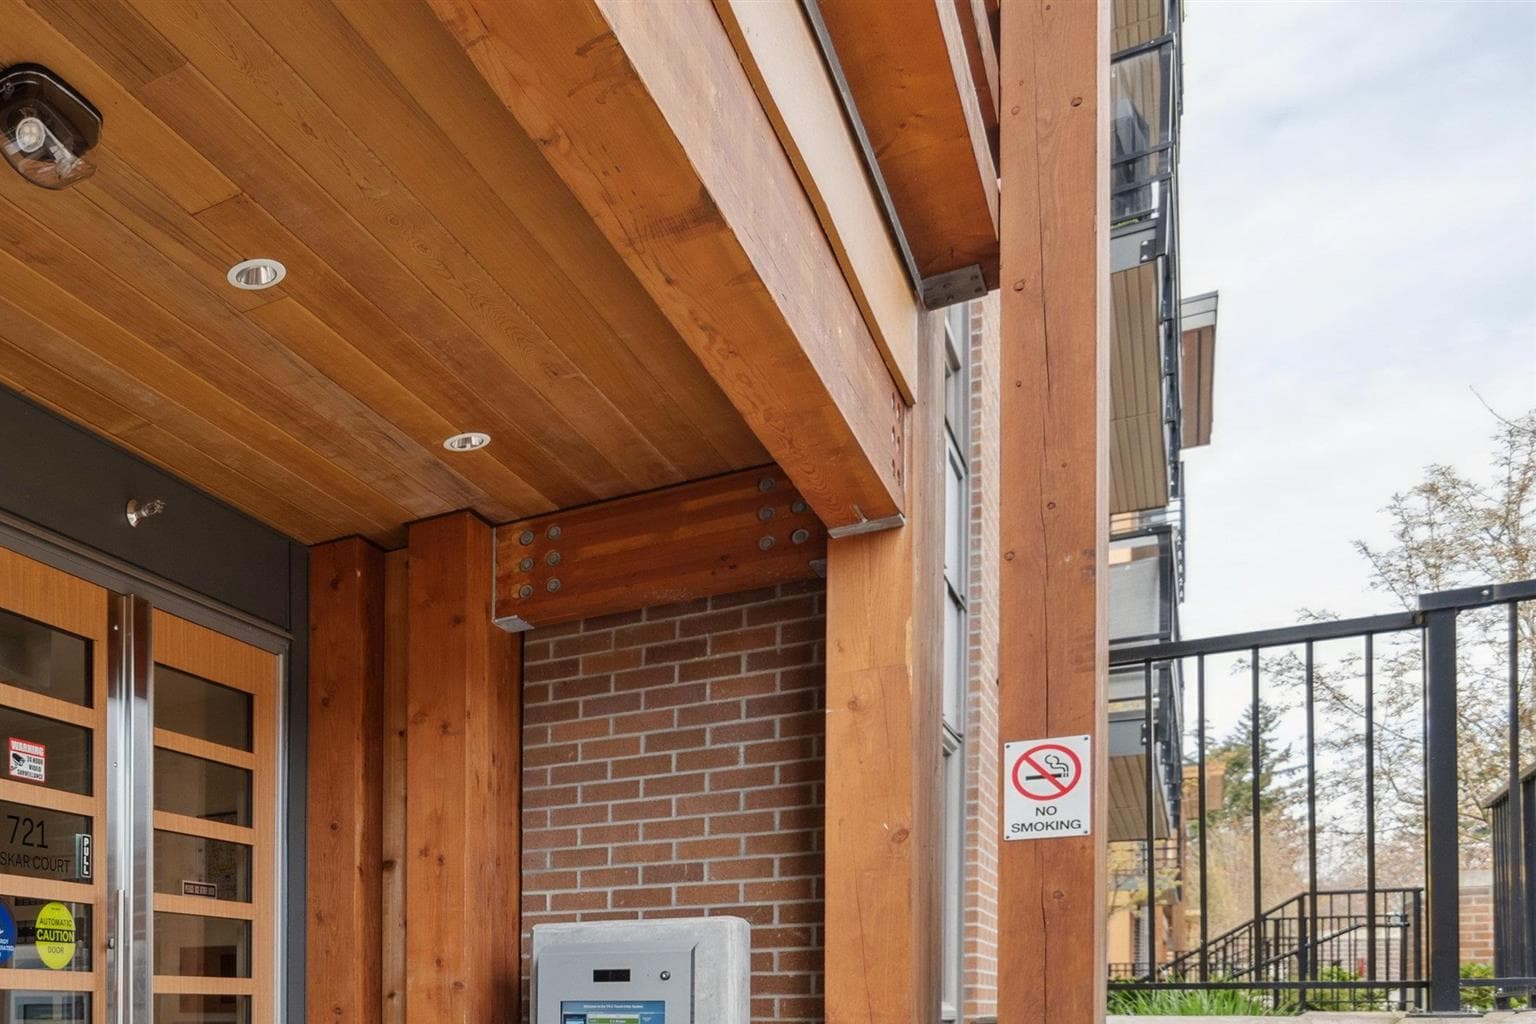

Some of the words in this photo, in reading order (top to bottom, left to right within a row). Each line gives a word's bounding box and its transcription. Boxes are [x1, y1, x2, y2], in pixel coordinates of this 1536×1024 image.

[1035, 805, 1057, 817] NO
[7, 815, 48, 849] 721
[1011, 819, 1082, 833] SMOKING
[82, 836, 90, 875] PULL
[33, 856, 72, 873] COURT
[39, 917, 73, 928] AUTOMATIC
[36, 929, 76, 943] CAUTION
[47, 946, 64, 954] DOOR
